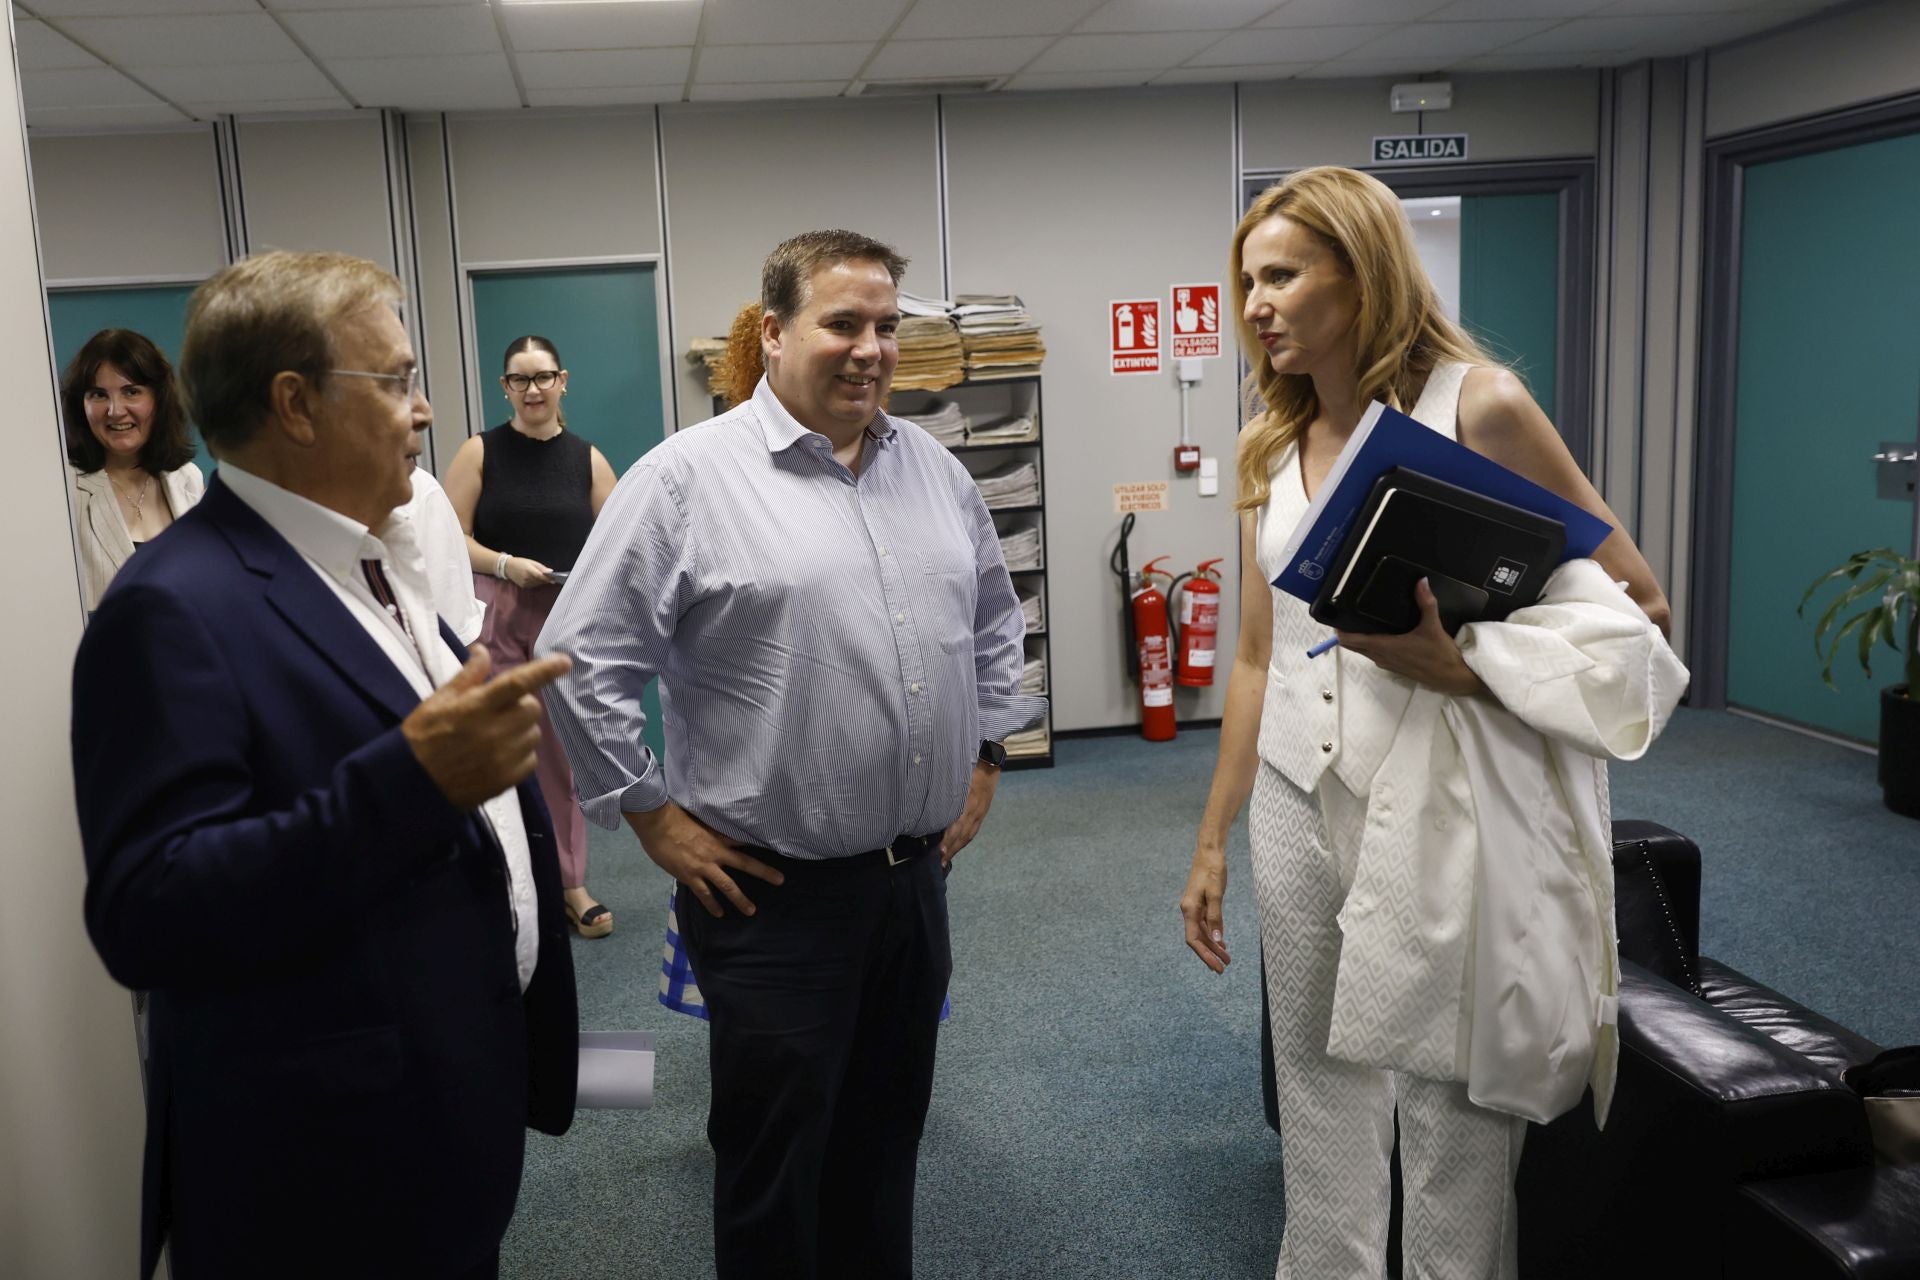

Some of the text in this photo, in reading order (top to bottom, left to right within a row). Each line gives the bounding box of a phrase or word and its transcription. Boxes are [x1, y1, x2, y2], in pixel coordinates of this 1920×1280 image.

[1379, 139, 1460, 159] SALIDA
[1174, 337, 1217, 348] PULSADOR
[1174, 346, 1217, 357] DE ALARMA
[1113, 357, 1158, 369] EXTINTOR
[1114, 484, 1145, 494] UTILIZAR
